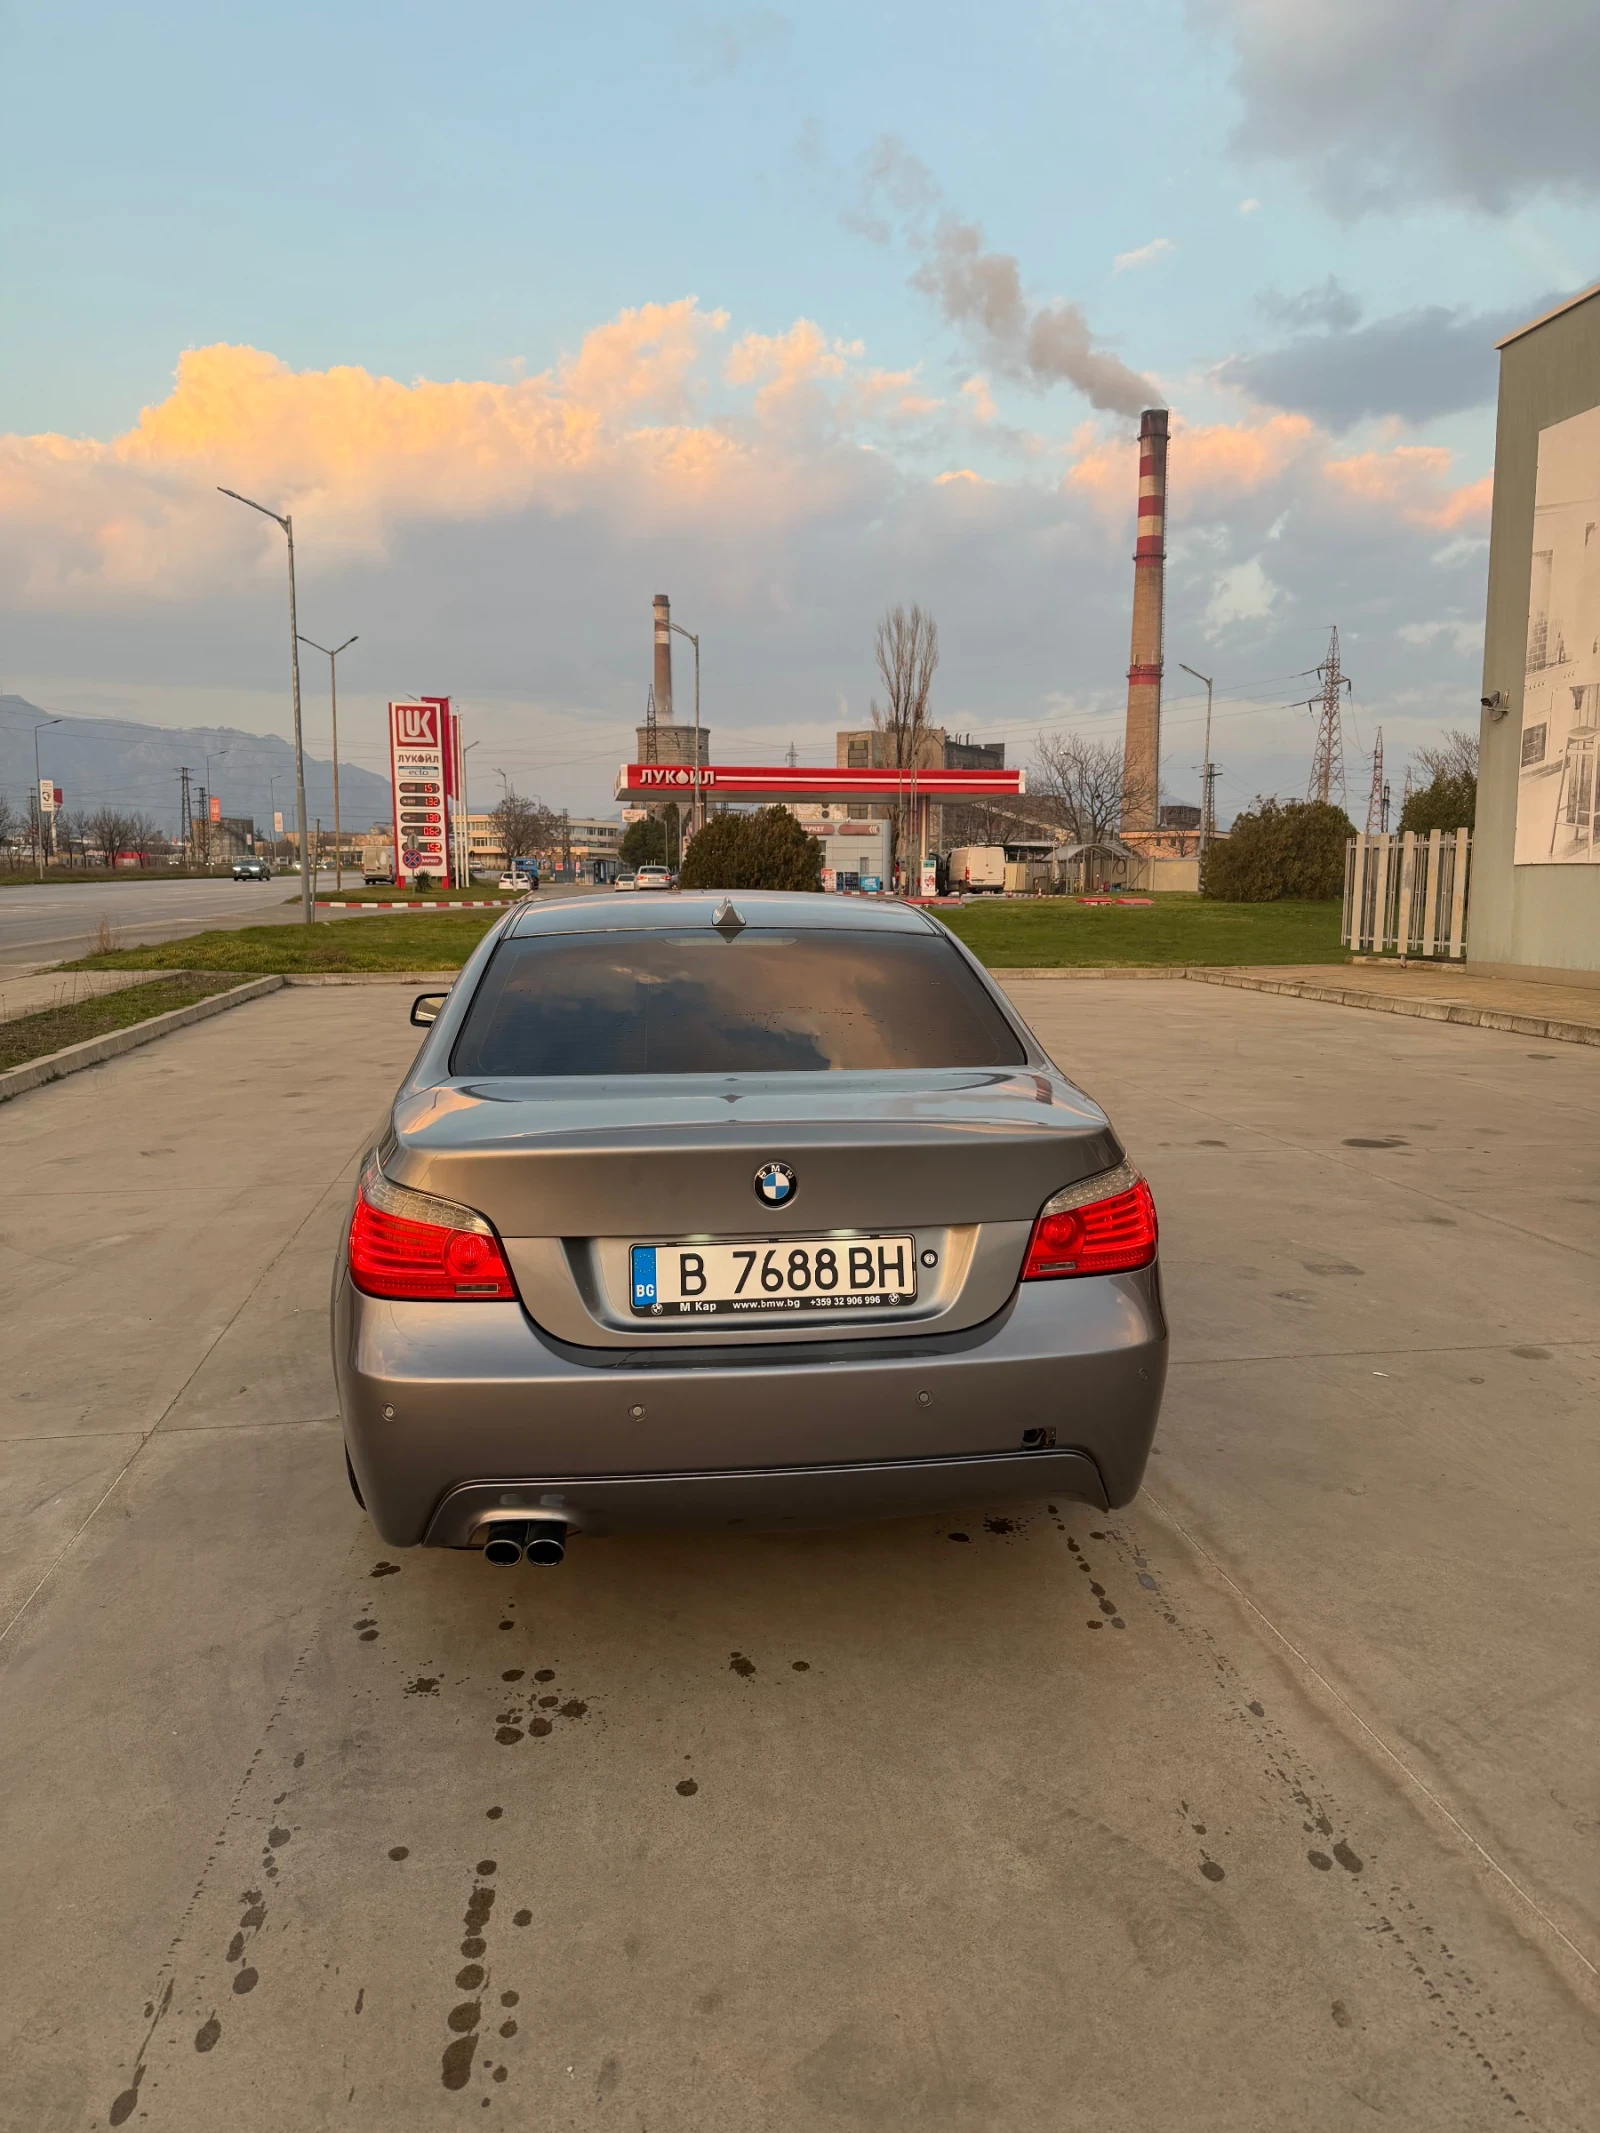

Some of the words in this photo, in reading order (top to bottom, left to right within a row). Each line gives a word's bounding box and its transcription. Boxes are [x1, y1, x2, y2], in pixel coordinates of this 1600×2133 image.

[397, 753, 439, 763] ЛУКОЙЛ
[640, 767, 715, 785] ЛУКОЙЛ
[757, 1165, 795, 1179] BMW
[680, 1253, 707, 1296] B
[732, 1248, 838, 1294] 7688
[848, 1245, 905, 1289] BH
[636, 1284, 655, 1298] BG
[732, 1298, 800, 1310] www.bmw.bg
[810, 1297, 832, 1306] +359
[834, 1297, 844, 1305] 32
[846, 1296, 863, 1305] 906
[865, 1295, 881, 1304] 996
